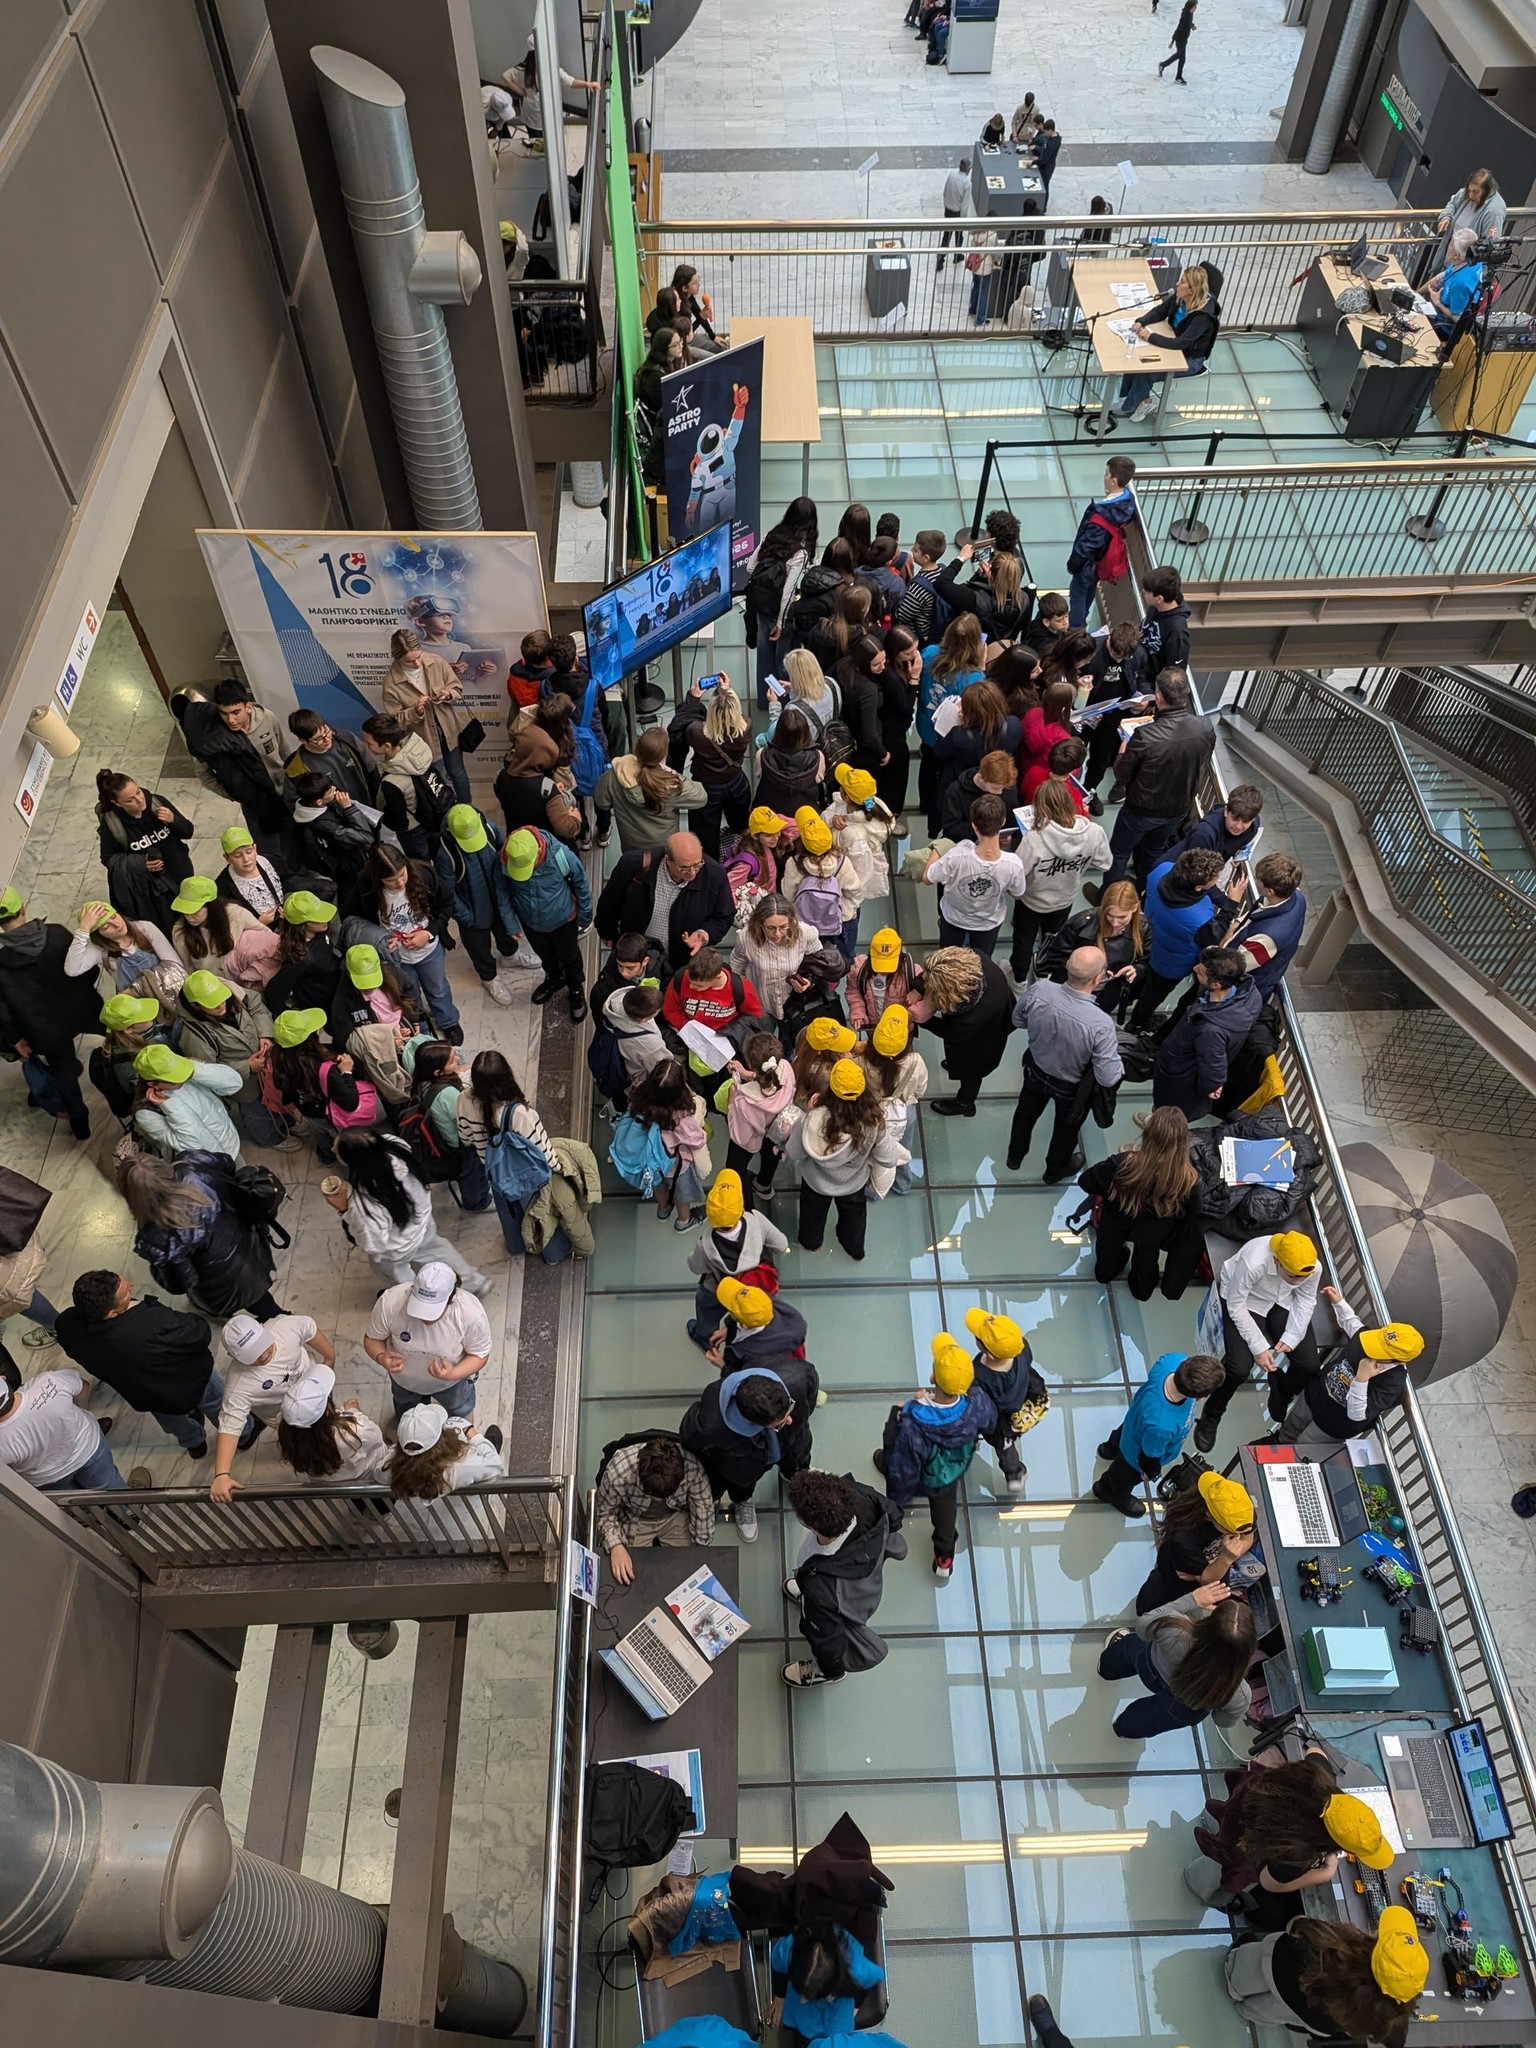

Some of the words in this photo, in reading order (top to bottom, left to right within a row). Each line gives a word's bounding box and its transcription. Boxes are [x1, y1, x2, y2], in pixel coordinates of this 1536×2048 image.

[667, 407, 701, 428] ASTRO
[667, 416, 701, 437] PARTY
[318, 552, 376, 599] 18
[646, 560, 674, 603] 18
[307, 607, 358, 616] ΜΑΘΗΤΙΚΟ
[359, 607, 407, 616] ΣΥΝΕΔΡΙΟ
[321, 617, 399, 626] ΠΛΗΡΟΦΟΡΙΚΗΣ
[75, 636, 89, 662] WC
